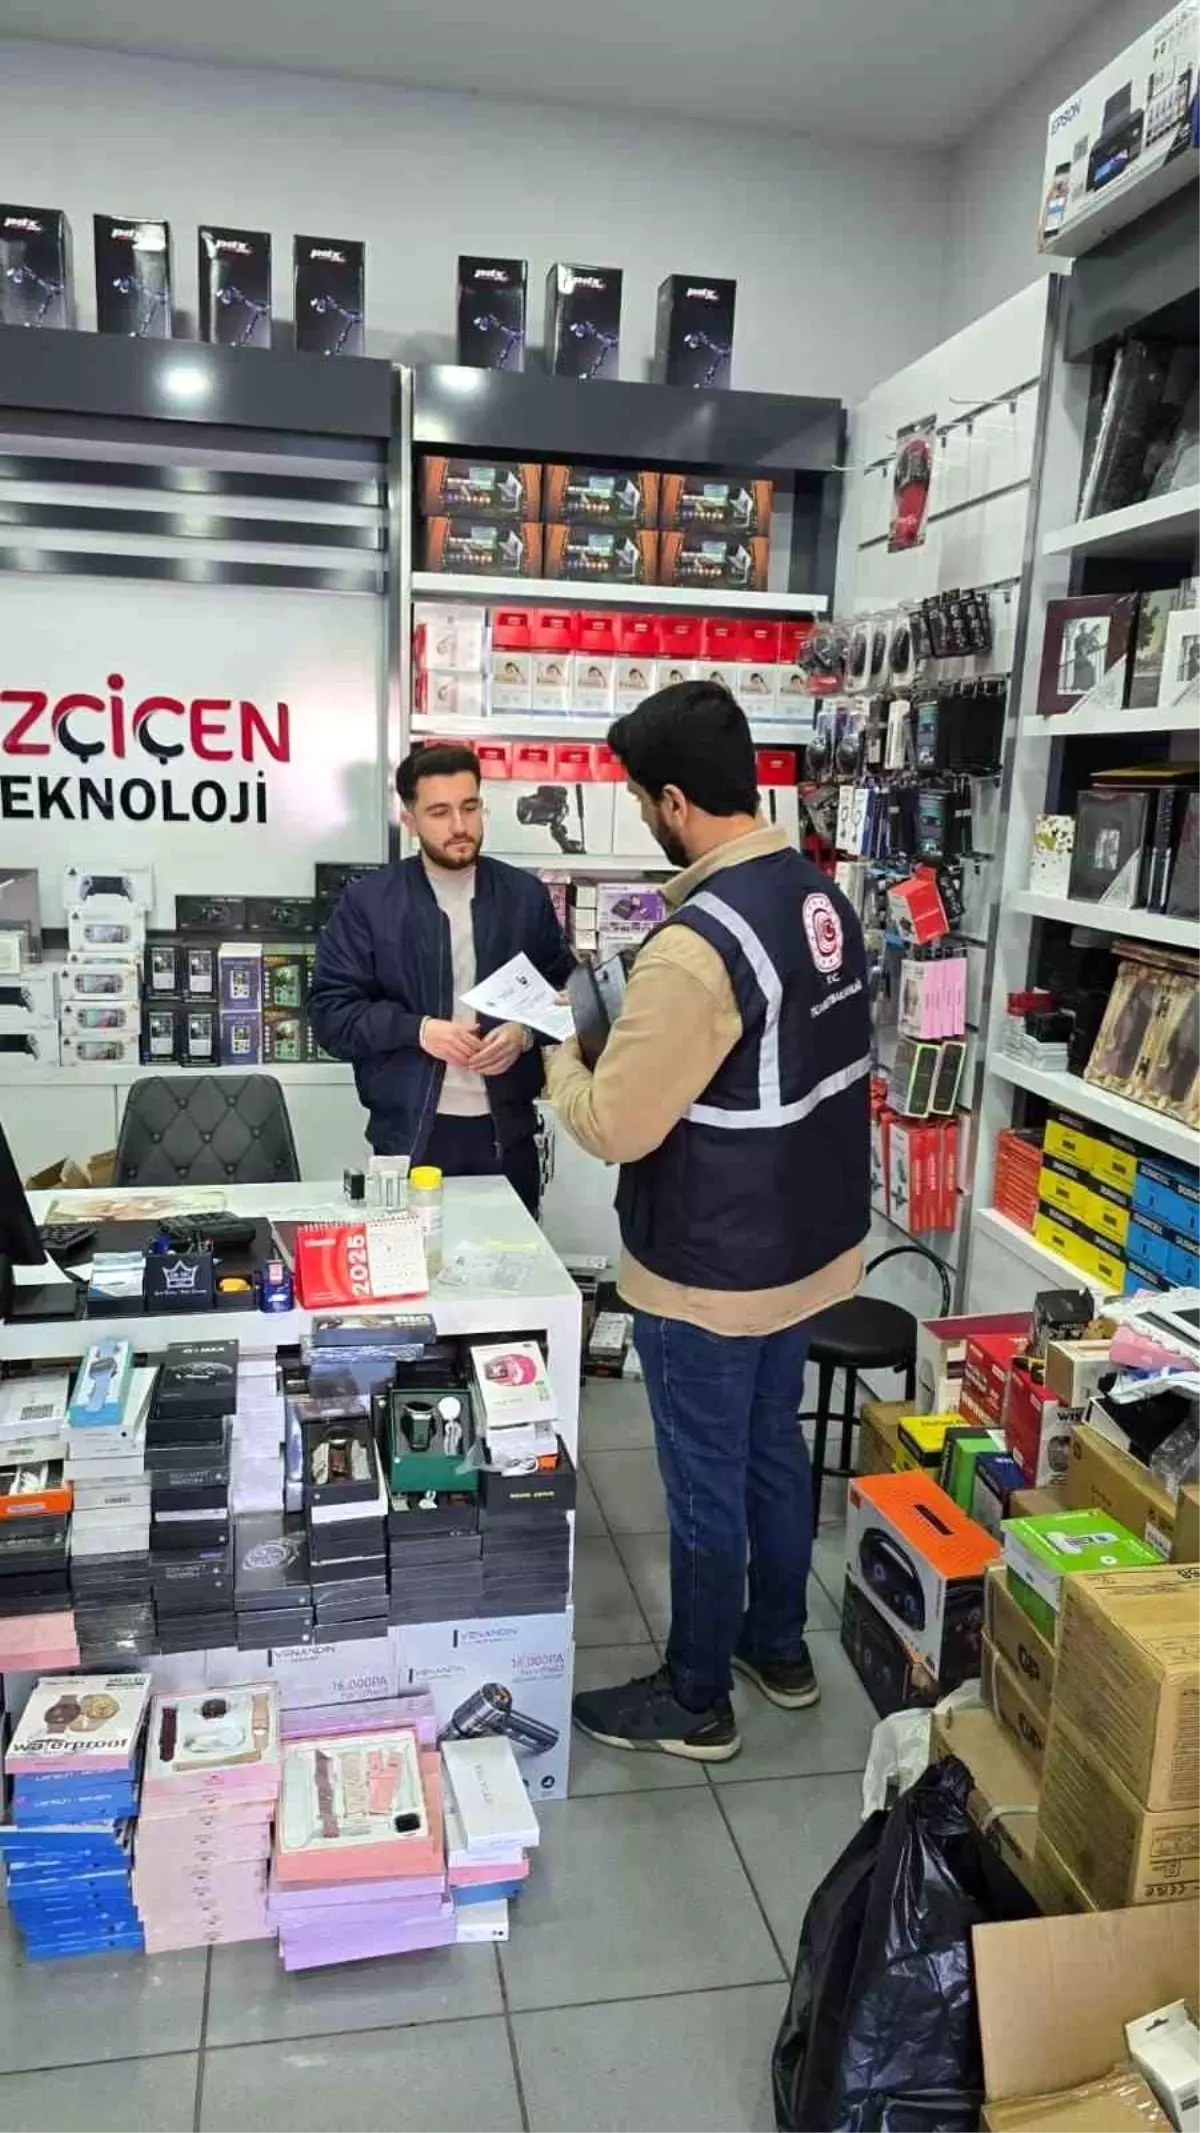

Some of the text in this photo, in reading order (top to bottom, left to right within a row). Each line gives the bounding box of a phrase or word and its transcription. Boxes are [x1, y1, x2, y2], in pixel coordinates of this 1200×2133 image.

[1050, 99, 1081, 136] EPSON
[0, 673, 291, 765] ZÇİÇEN
[0, 770, 267, 823] EKNOLOJİ
[347, 1234, 372, 1297] 2025
[13, 1737, 128, 1755] waterproof
